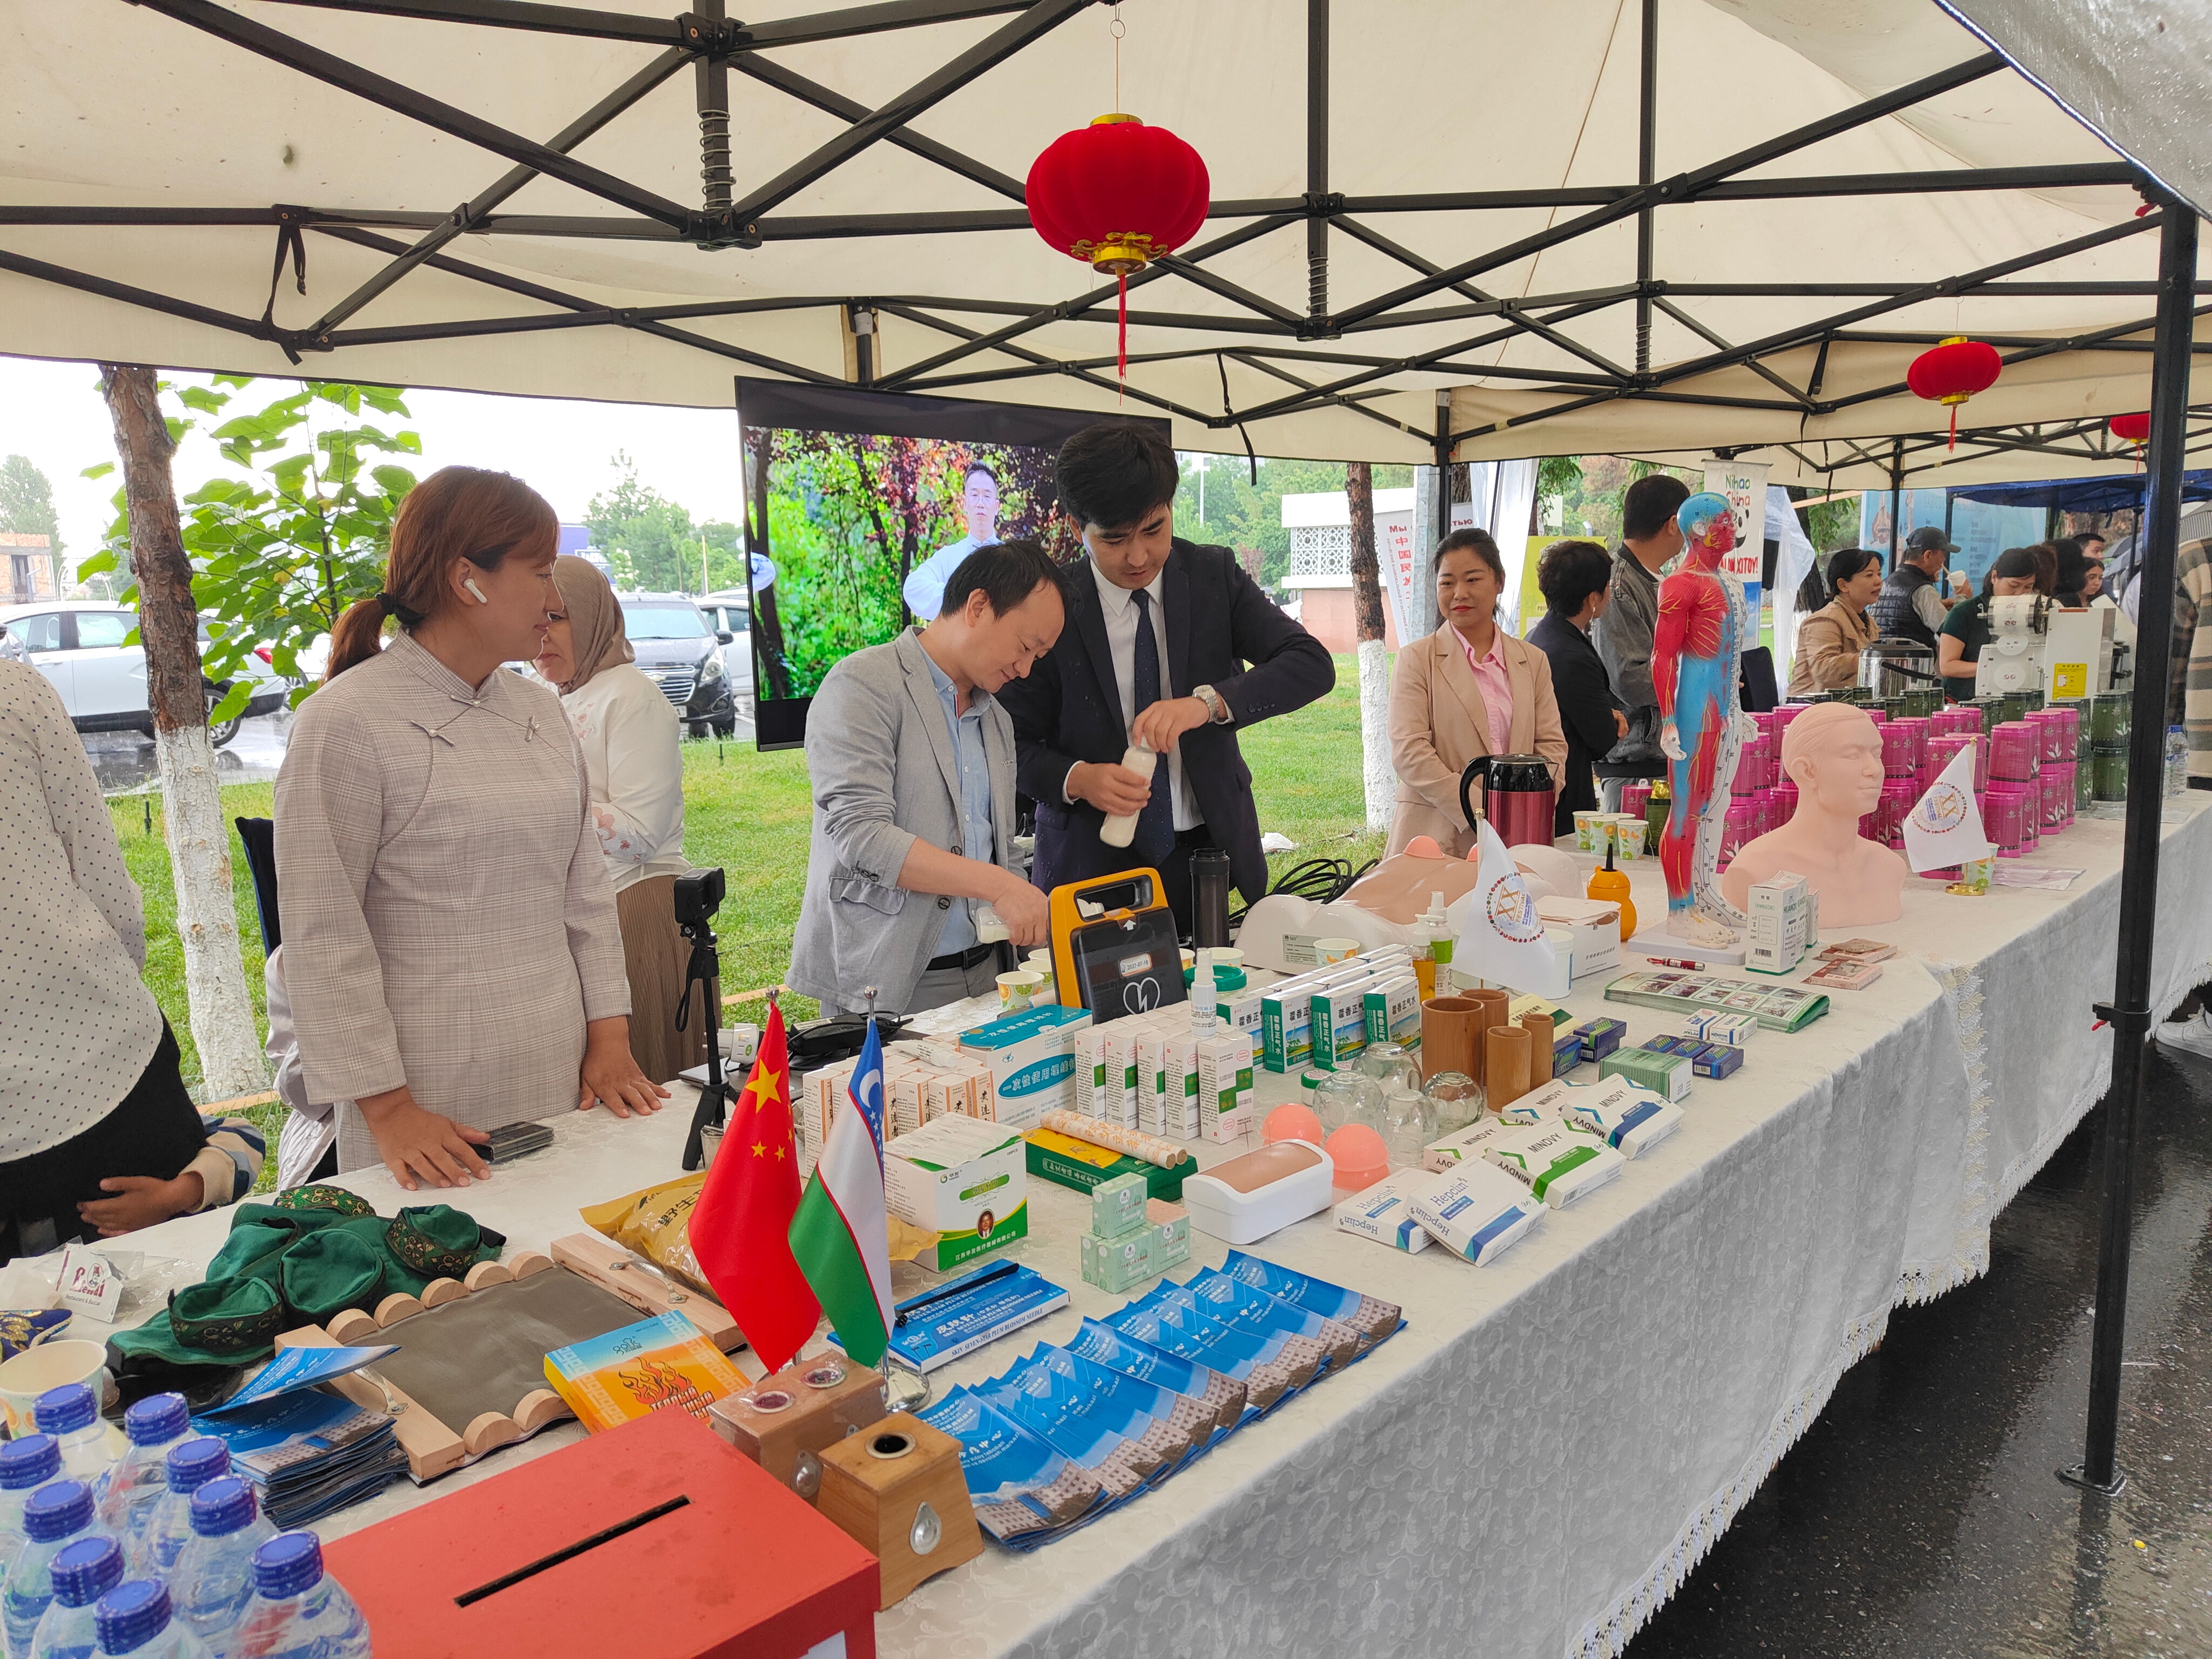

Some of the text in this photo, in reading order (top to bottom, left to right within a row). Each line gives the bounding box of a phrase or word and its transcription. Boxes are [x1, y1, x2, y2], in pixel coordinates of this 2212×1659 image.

[1725, 474, 1750, 490] Nihao
[1726, 491, 1750, 506] China
[1451, 518, 1473, 527] тью
[1736, 556, 1758, 575] XITOY!
[1515, 893, 1526, 923] FESTIVAL
[1290, 1006, 1312, 1021] 藿香正
[1535, 1089, 1566, 1107] MINDVY
[1599, 1089, 1628, 1108] MINDVY
[1573, 1116, 1606, 1138] MINDVY
[1462, 1128, 1497, 1146] MINDVY
[1527, 1132, 1563, 1154] MINDVY
[1498, 1161, 1531, 1186] MINDVY
[1357, 1186, 1394, 1210] Hepclin
[1430, 1179, 1467, 1206] Hepclin
[1344, 1216, 1379, 1235] Hepclin
[1415, 1206, 1451, 1237] Hepclin
[952, 1347, 963, 1357] SKIN
[991, 1325, 1005, 1338] PLUM
[1004, 1317, 1027, 1331] BLOSSOM
[1026, 1308, 1043, 1320] NEEDLE
